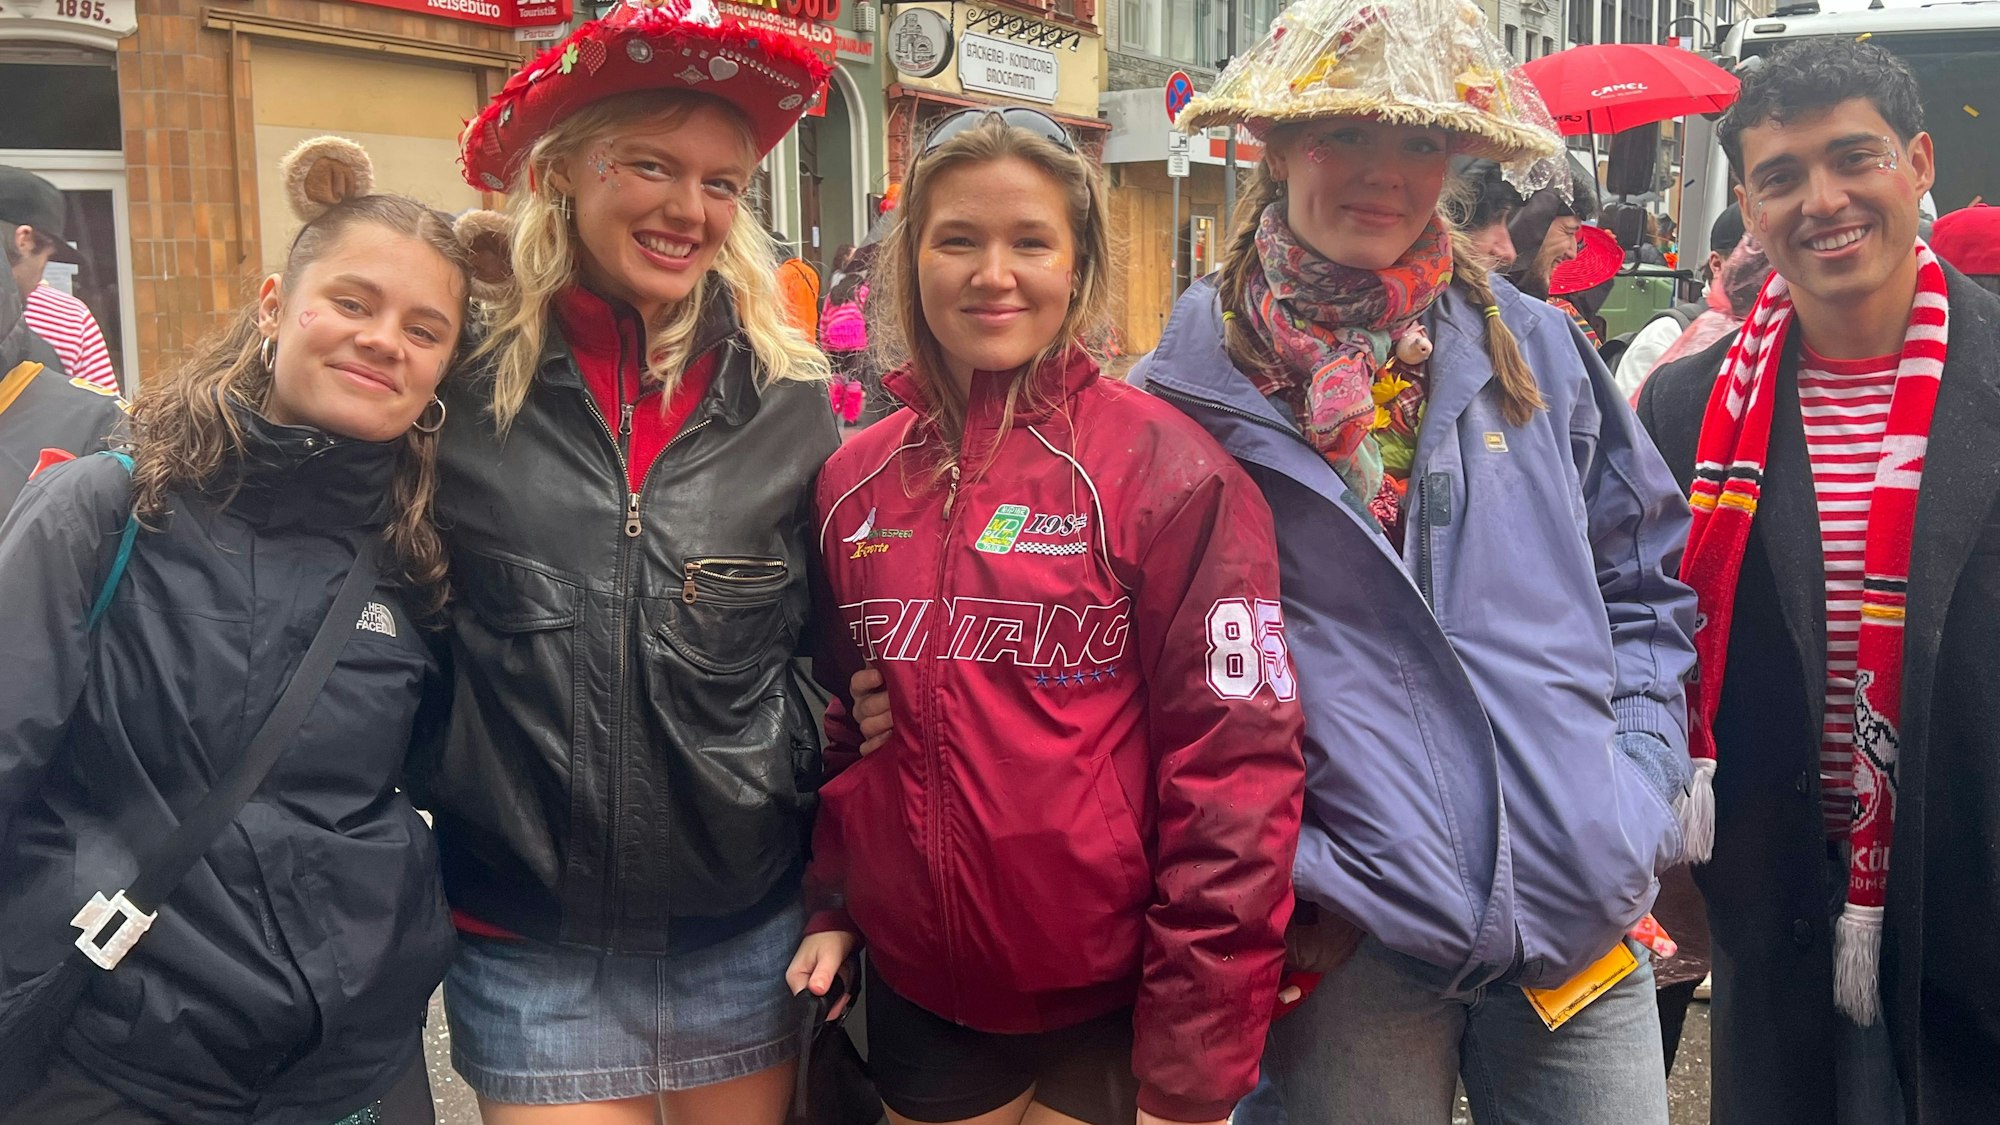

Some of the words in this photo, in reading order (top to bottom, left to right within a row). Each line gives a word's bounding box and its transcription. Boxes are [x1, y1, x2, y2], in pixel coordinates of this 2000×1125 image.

[519, 6, 557, 18] Touristik
[717, 1, 797, 29] BRODWOOSCH
[523, 29, 555, 39] Partner
[798, 22, 832, 44] 4,50
[966, 42, 1005, 64] BÄCKEREI
[1009, 52, 1053, 74] KONDITOREI
[1591, 83, 1648, 97] CAMEL
[356, 619, 382, 633] FACE
[1204, 597, 1296, 702] 85
